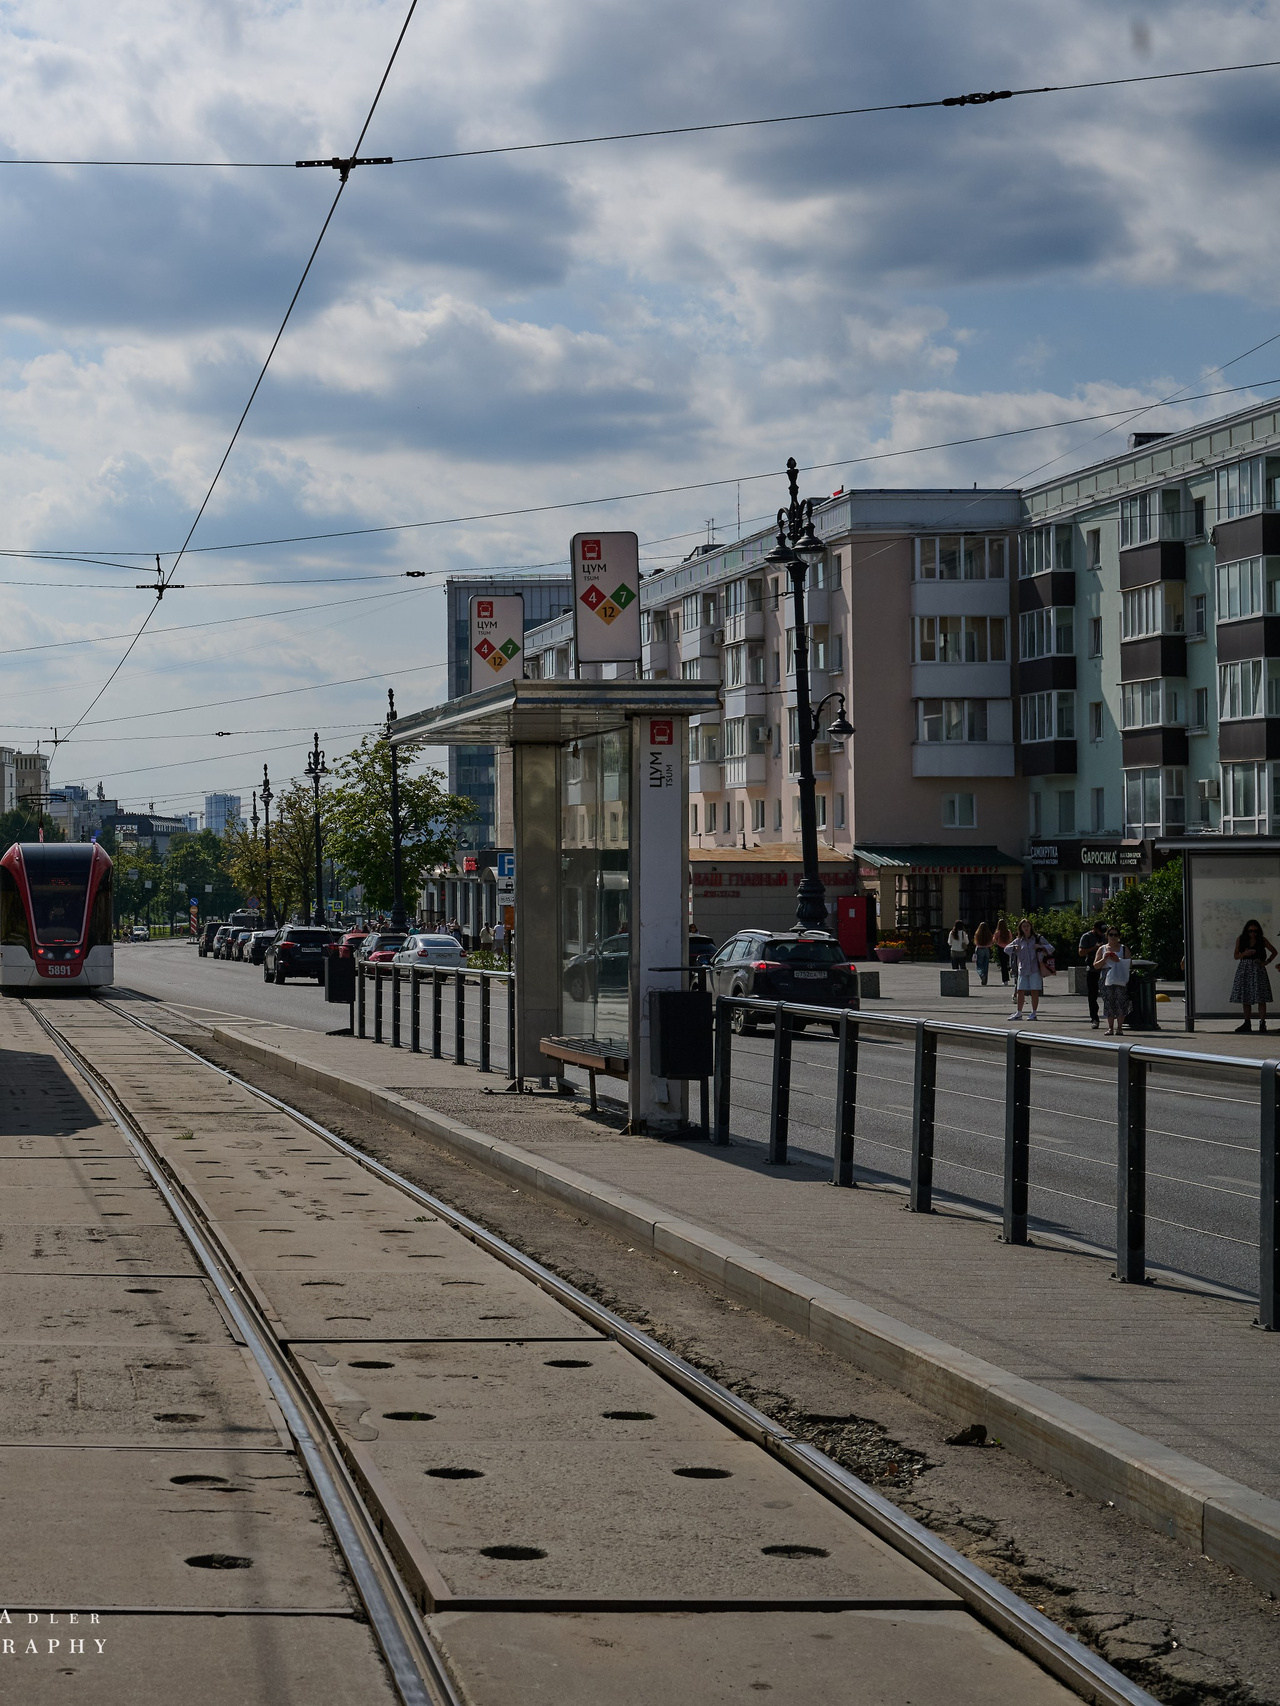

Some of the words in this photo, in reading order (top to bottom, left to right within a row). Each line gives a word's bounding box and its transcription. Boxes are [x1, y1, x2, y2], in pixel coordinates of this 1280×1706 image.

[582, 563, 607, 574] ЦУМ
[588, 592, 597, 603] 4
[619, 592, 627, 602] 7
[602, 606, 615, 618] 12
[477, 621, 498, 630] ЦУМ
[481, 644, 488, 654] 4
[506, 645, 513, 654] 7
[491, 656, 503, 666] 12
[649, 751, 663, 788] ЦУМ
[665, 764, 673, 788] TSUM
[1081, 847, 1117, 864] GAPOCHKA
[694, 873, 723, 886] ВАШ
[729, 870, 788, 886] ГЛАВНЫЙ
[48, 965, 71, 976] 5891
